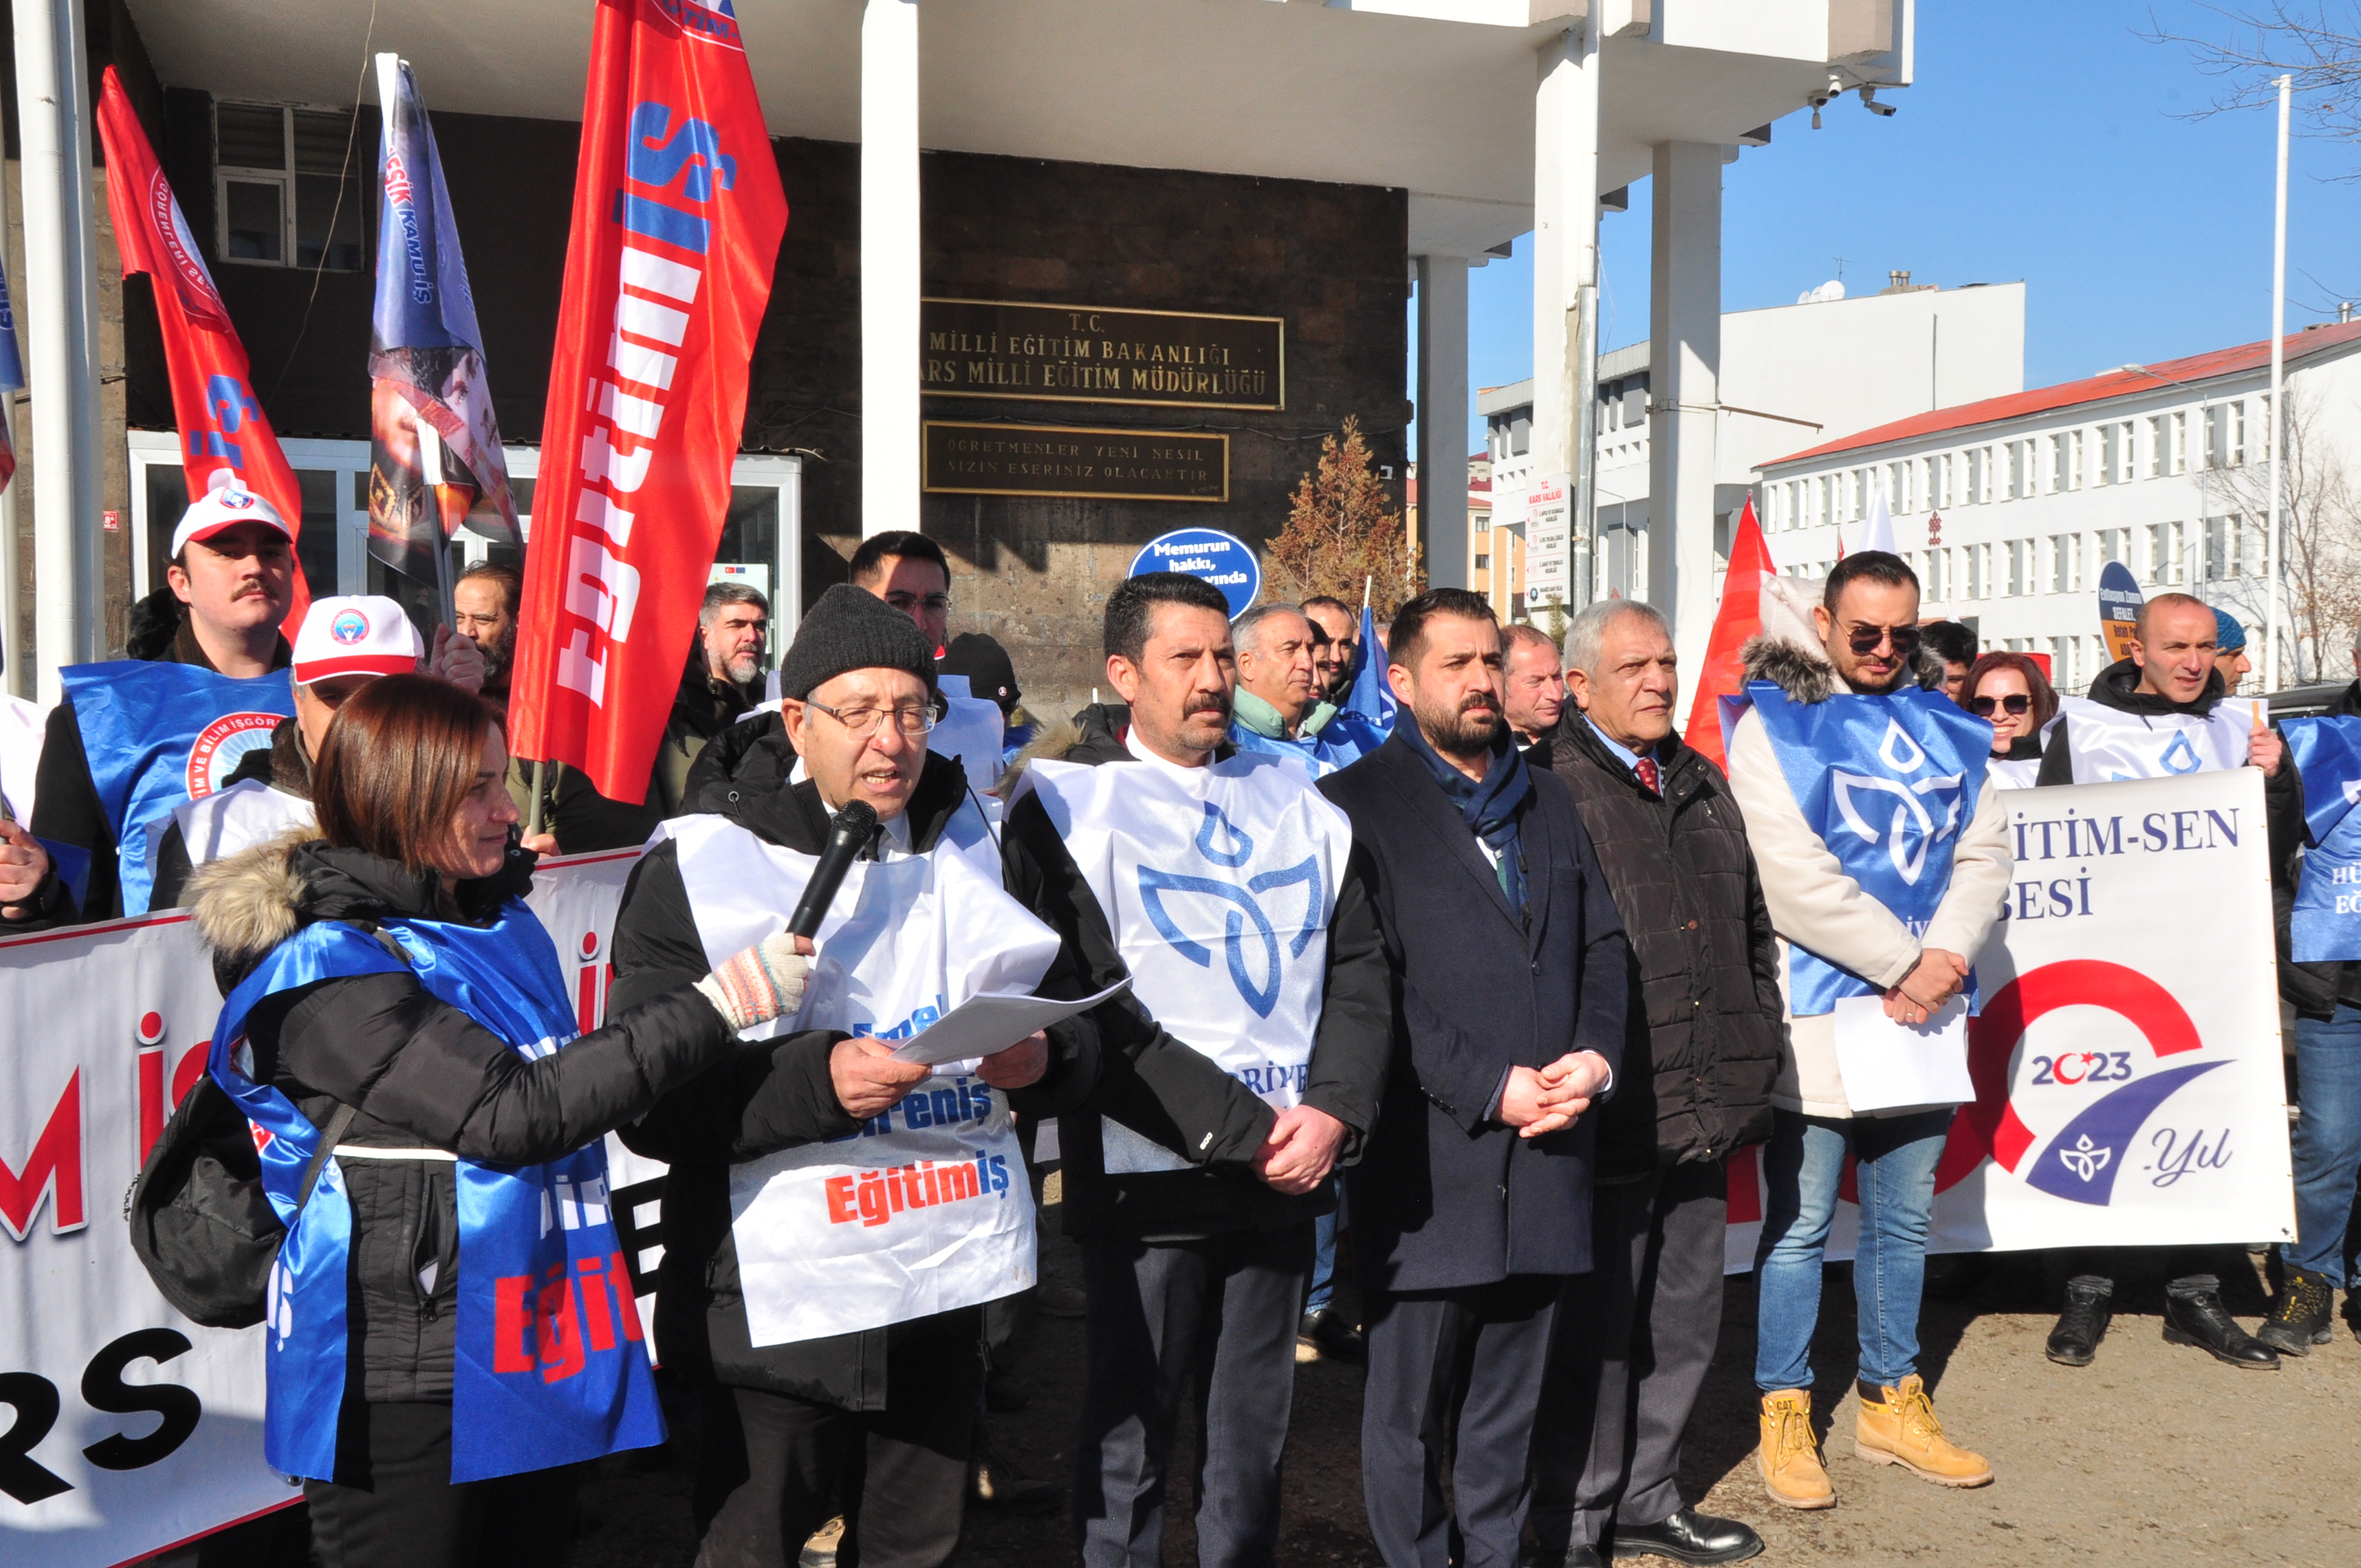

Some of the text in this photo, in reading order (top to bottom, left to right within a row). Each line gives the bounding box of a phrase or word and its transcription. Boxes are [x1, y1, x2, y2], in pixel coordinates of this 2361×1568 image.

[396, 209, 435, 305] KAMU-İŞ
[1069, 313, 1105, 333] T.C.
[929, 330, 1230, 365] MİLLİ EĞİTİM BAKANLIĞI
[968, 357, 1031, 385] MİLLİ
[1043, 360, 1120, 389] EĞİTİM
[1131, 365, 1266, 396] MÜDÜRLÜĞÜ
[1152, 448, 1203, 461] NESİL
[1008, 462, 1093, 477] ESERİNİZ
[1153, 541, 1230, 556] Memurun
[1169, 557, 1216, 572] hakkı,
[228, 716, 280, 730] İŞGÖR
[200, 724, 231, 753] BİLİM
[194, 757, 207, 773] VE
